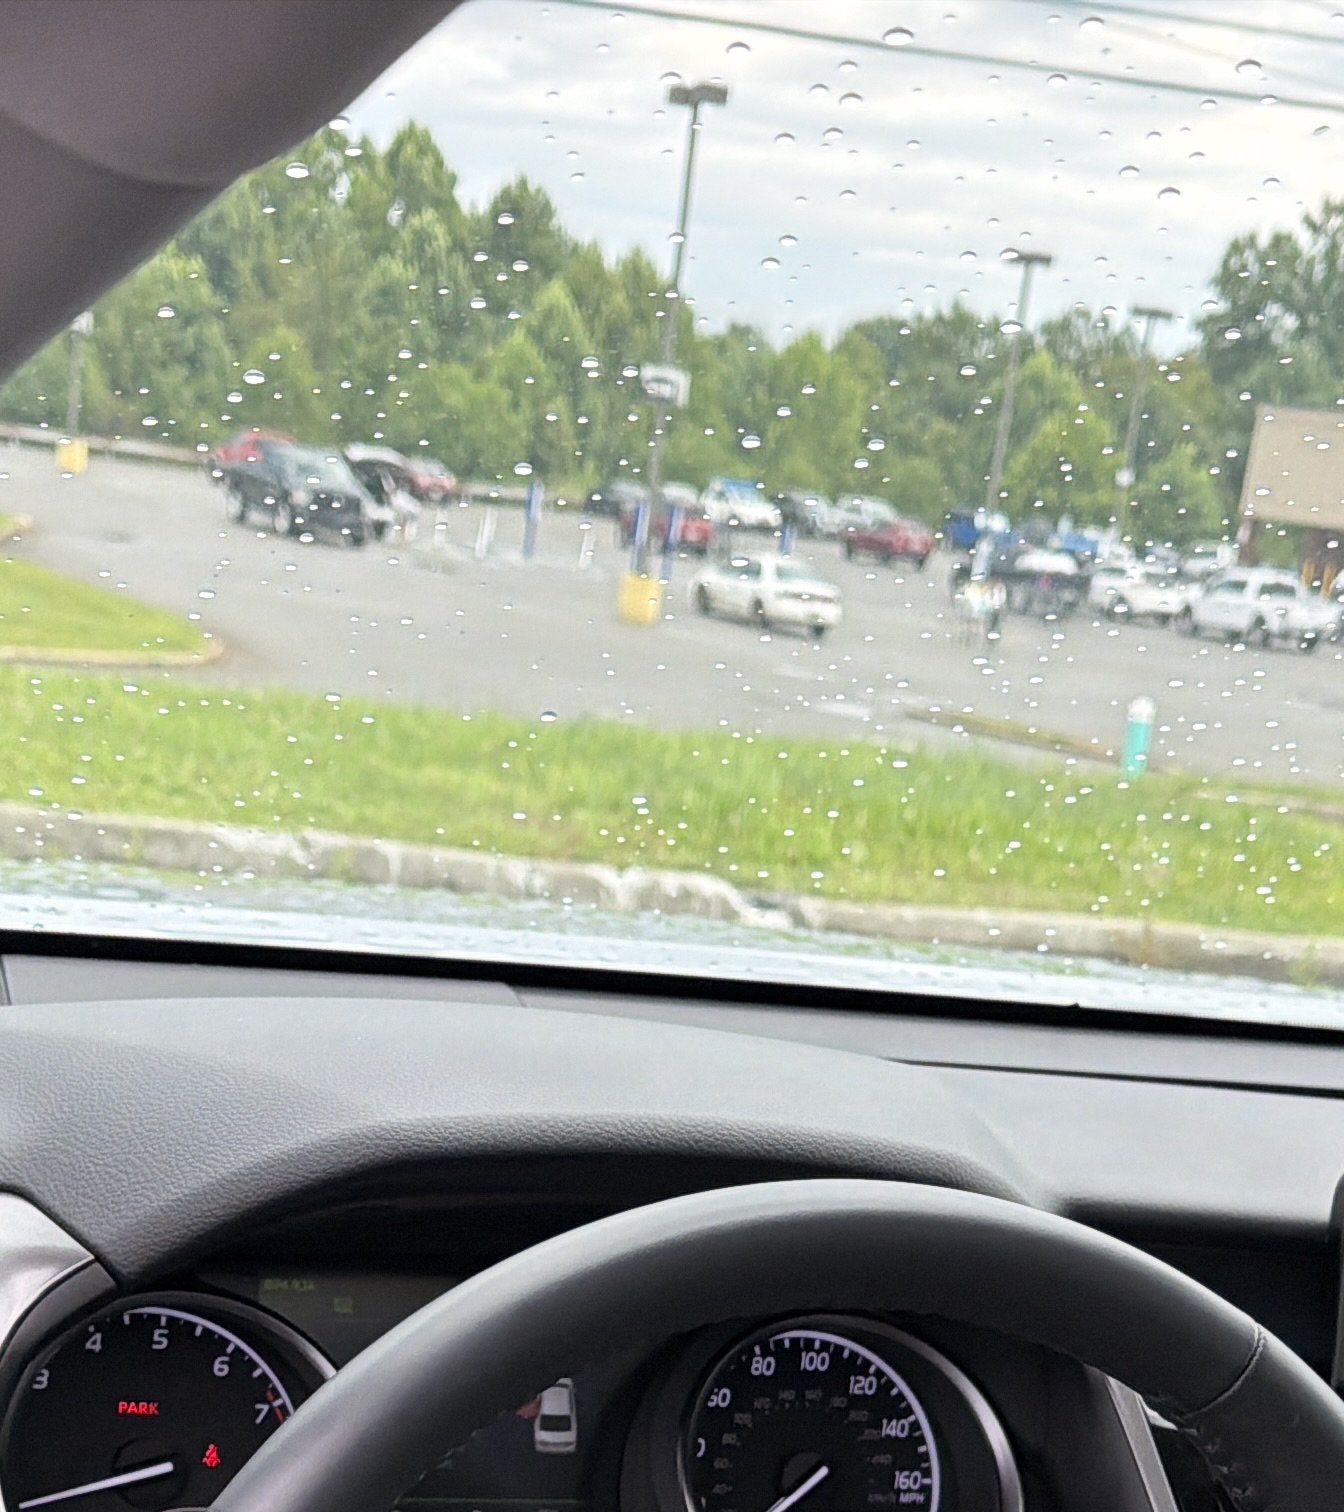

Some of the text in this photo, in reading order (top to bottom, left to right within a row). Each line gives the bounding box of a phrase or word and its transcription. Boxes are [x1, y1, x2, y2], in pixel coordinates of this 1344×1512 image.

[85, 1333, 102, 1352] 4
[152, 1328, 169, 1350] 5
[213, 1356, 230, 1377] 6
[750, 1356, 776, 1376] 80
[800, 1351, 830, 1372] 100
[32, 1368, 50, 1390] 3
[849, 1375, 877, 1395] 120
[118, 1401, 160, 1416] PARK
[255, 1404, 270, 1424] 7
[881, 1418, 909, 1438] 140
[894, 1470, 922, 1490] 160
[899, 1492, 925, 1504] MPH
